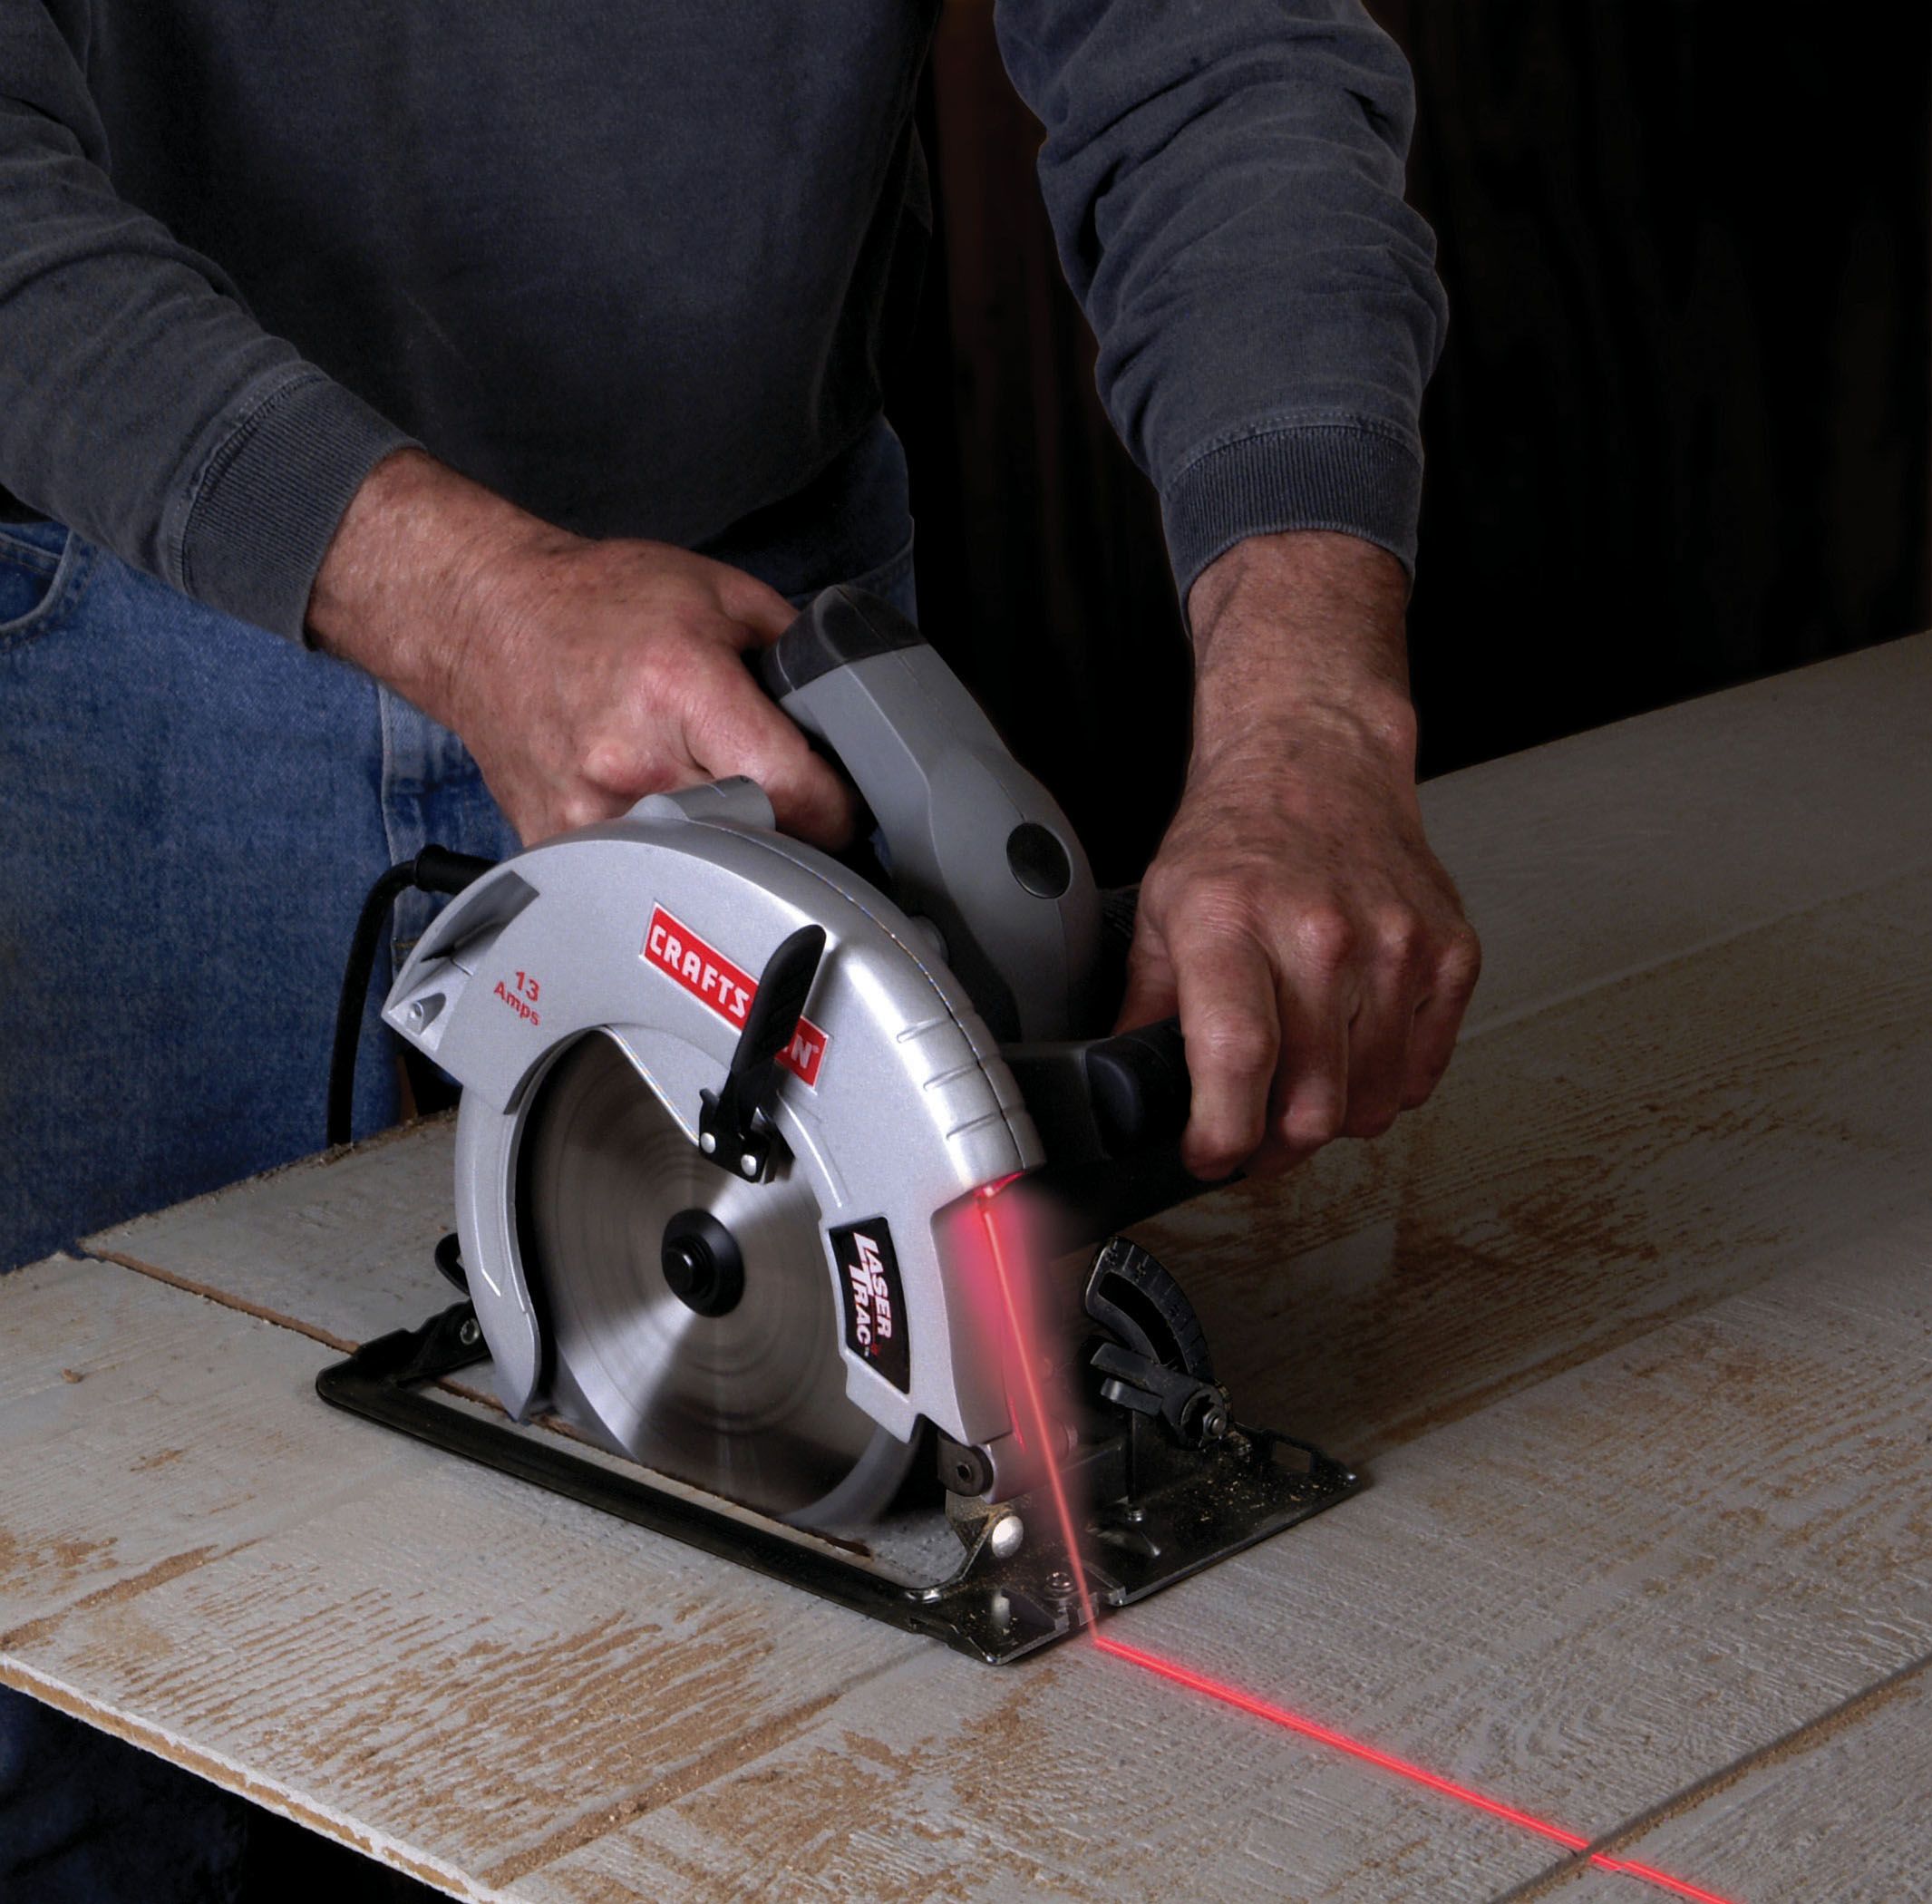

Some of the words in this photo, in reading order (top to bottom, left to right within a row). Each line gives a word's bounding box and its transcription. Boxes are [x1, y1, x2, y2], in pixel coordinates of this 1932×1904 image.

[493, 981, 540, 1026] Amps
[515, 971, 540, 1002] 13
[649, 924, 812, 1069] CRAFTSN
[849, 1261, 876, 1345] TRAC
[853, 1232, 892, 1339] LASER
